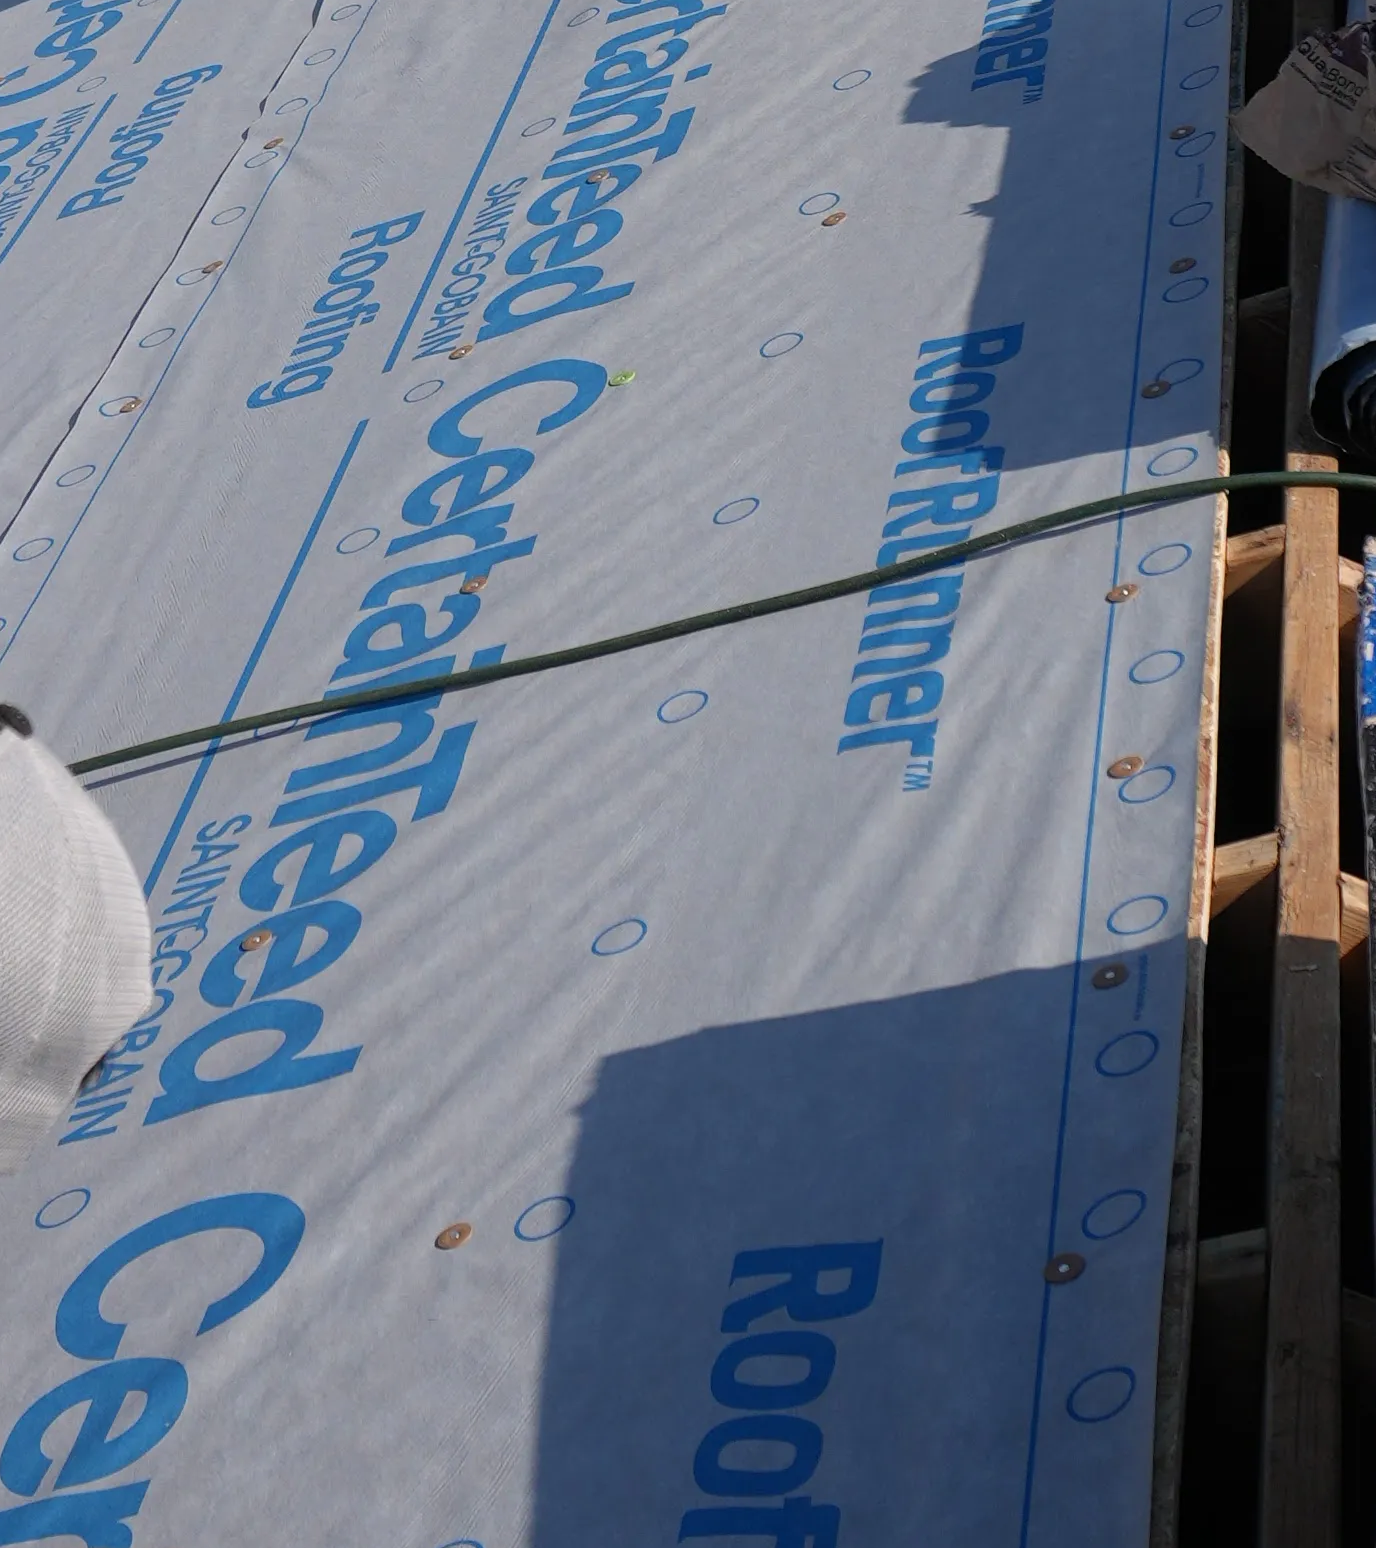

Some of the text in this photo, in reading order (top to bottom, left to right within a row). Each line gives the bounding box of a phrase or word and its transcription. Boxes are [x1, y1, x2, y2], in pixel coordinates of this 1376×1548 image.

[57, 63, 224, 221] Roofing
[245, 210, 425, 412] Roofing
[412, 176, 529, 363] SAINT-GOBAIN
[142, 354, 618, 1128] CertainTeed
